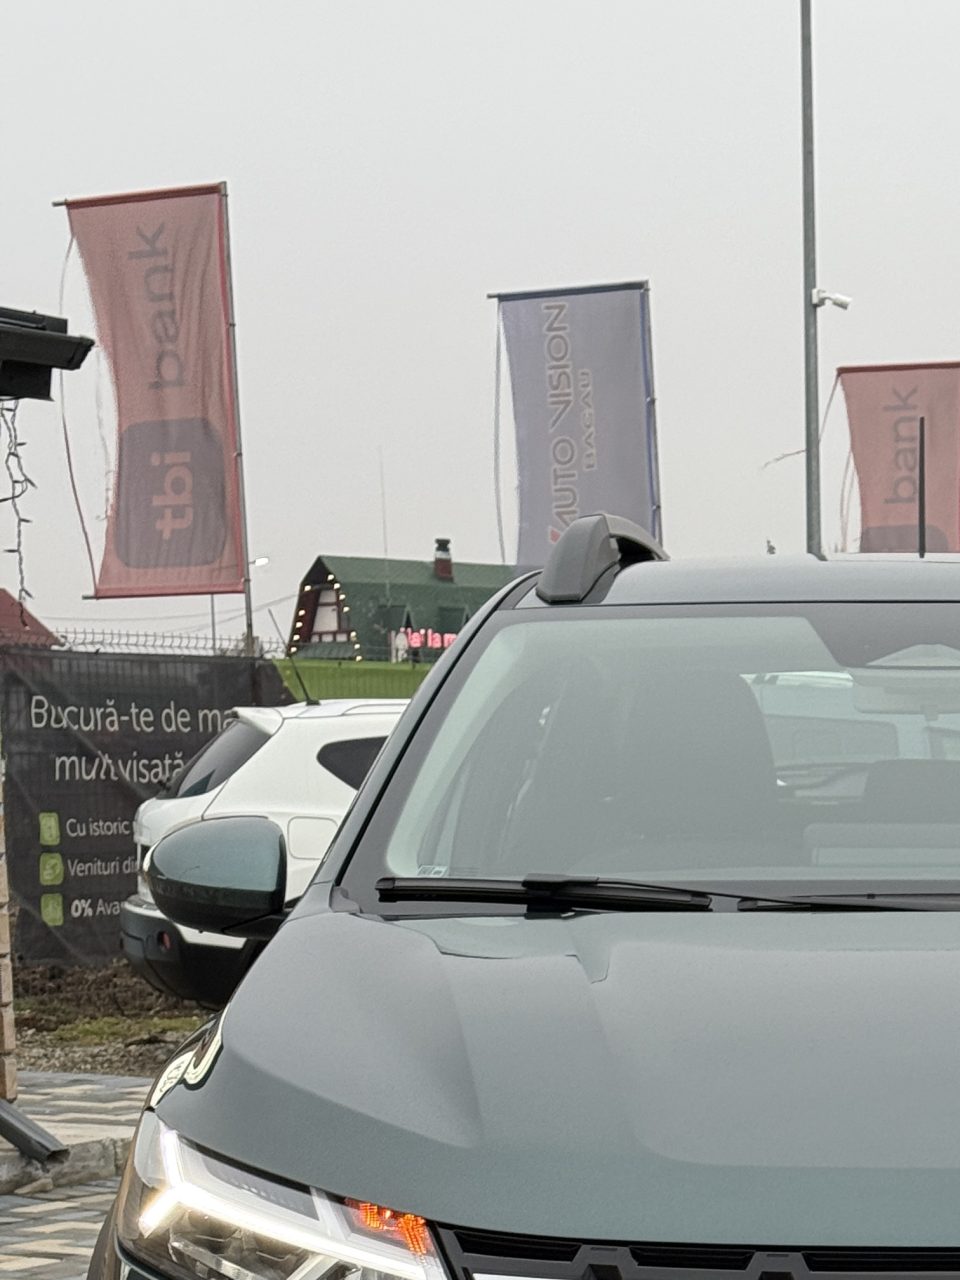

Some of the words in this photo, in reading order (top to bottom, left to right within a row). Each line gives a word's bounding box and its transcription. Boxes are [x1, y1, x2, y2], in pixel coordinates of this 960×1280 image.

[127, 221, 186, 390] bank
[543, 302, 574, 433] VISION
[884, 386, 918, 505] bank
[151, 450, 195, 540] tbi
[30, 695, 154, 732] Bucură-te
[161, 701, 192, 732] de
[66, 818, 87, 837] Cu
[89, 817, 131, 836] istoric
[67, 857, 120, 876] Venituri
[70, 899, 93, 918] 0%
